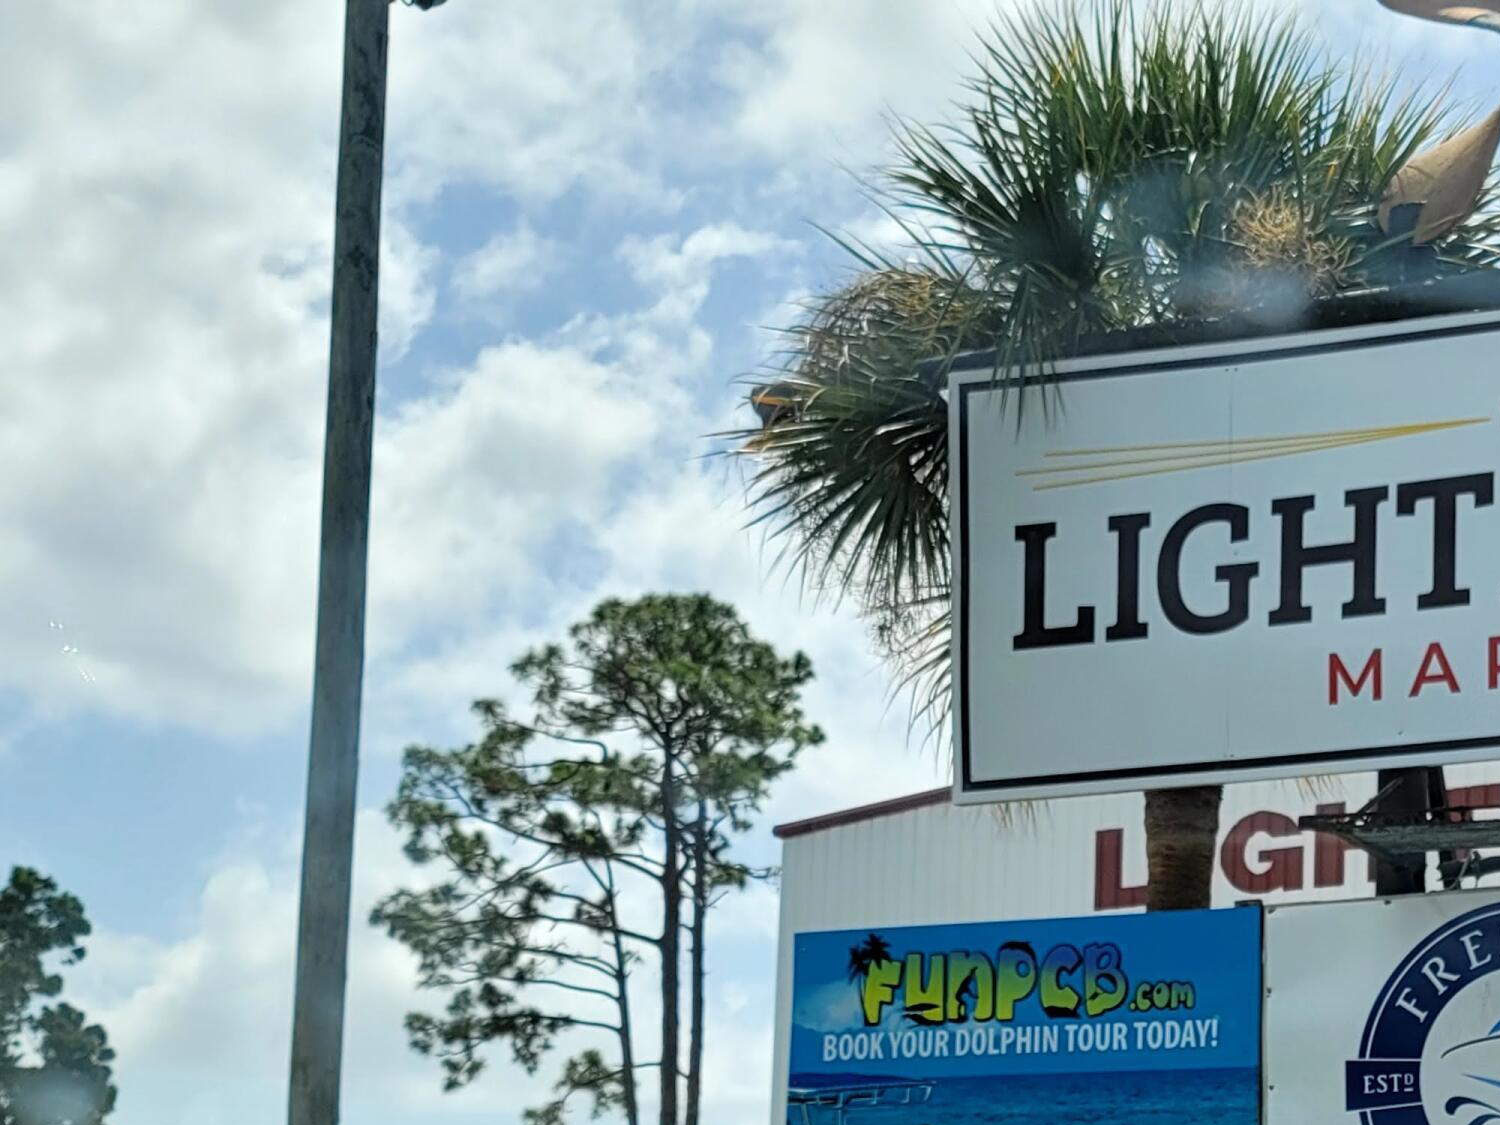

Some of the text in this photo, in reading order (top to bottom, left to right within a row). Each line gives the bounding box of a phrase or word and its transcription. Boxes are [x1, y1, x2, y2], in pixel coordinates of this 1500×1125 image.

[822, 1018, 1219, 1062] BOOK YOUR DOLPHIN TOUR TODAY!
